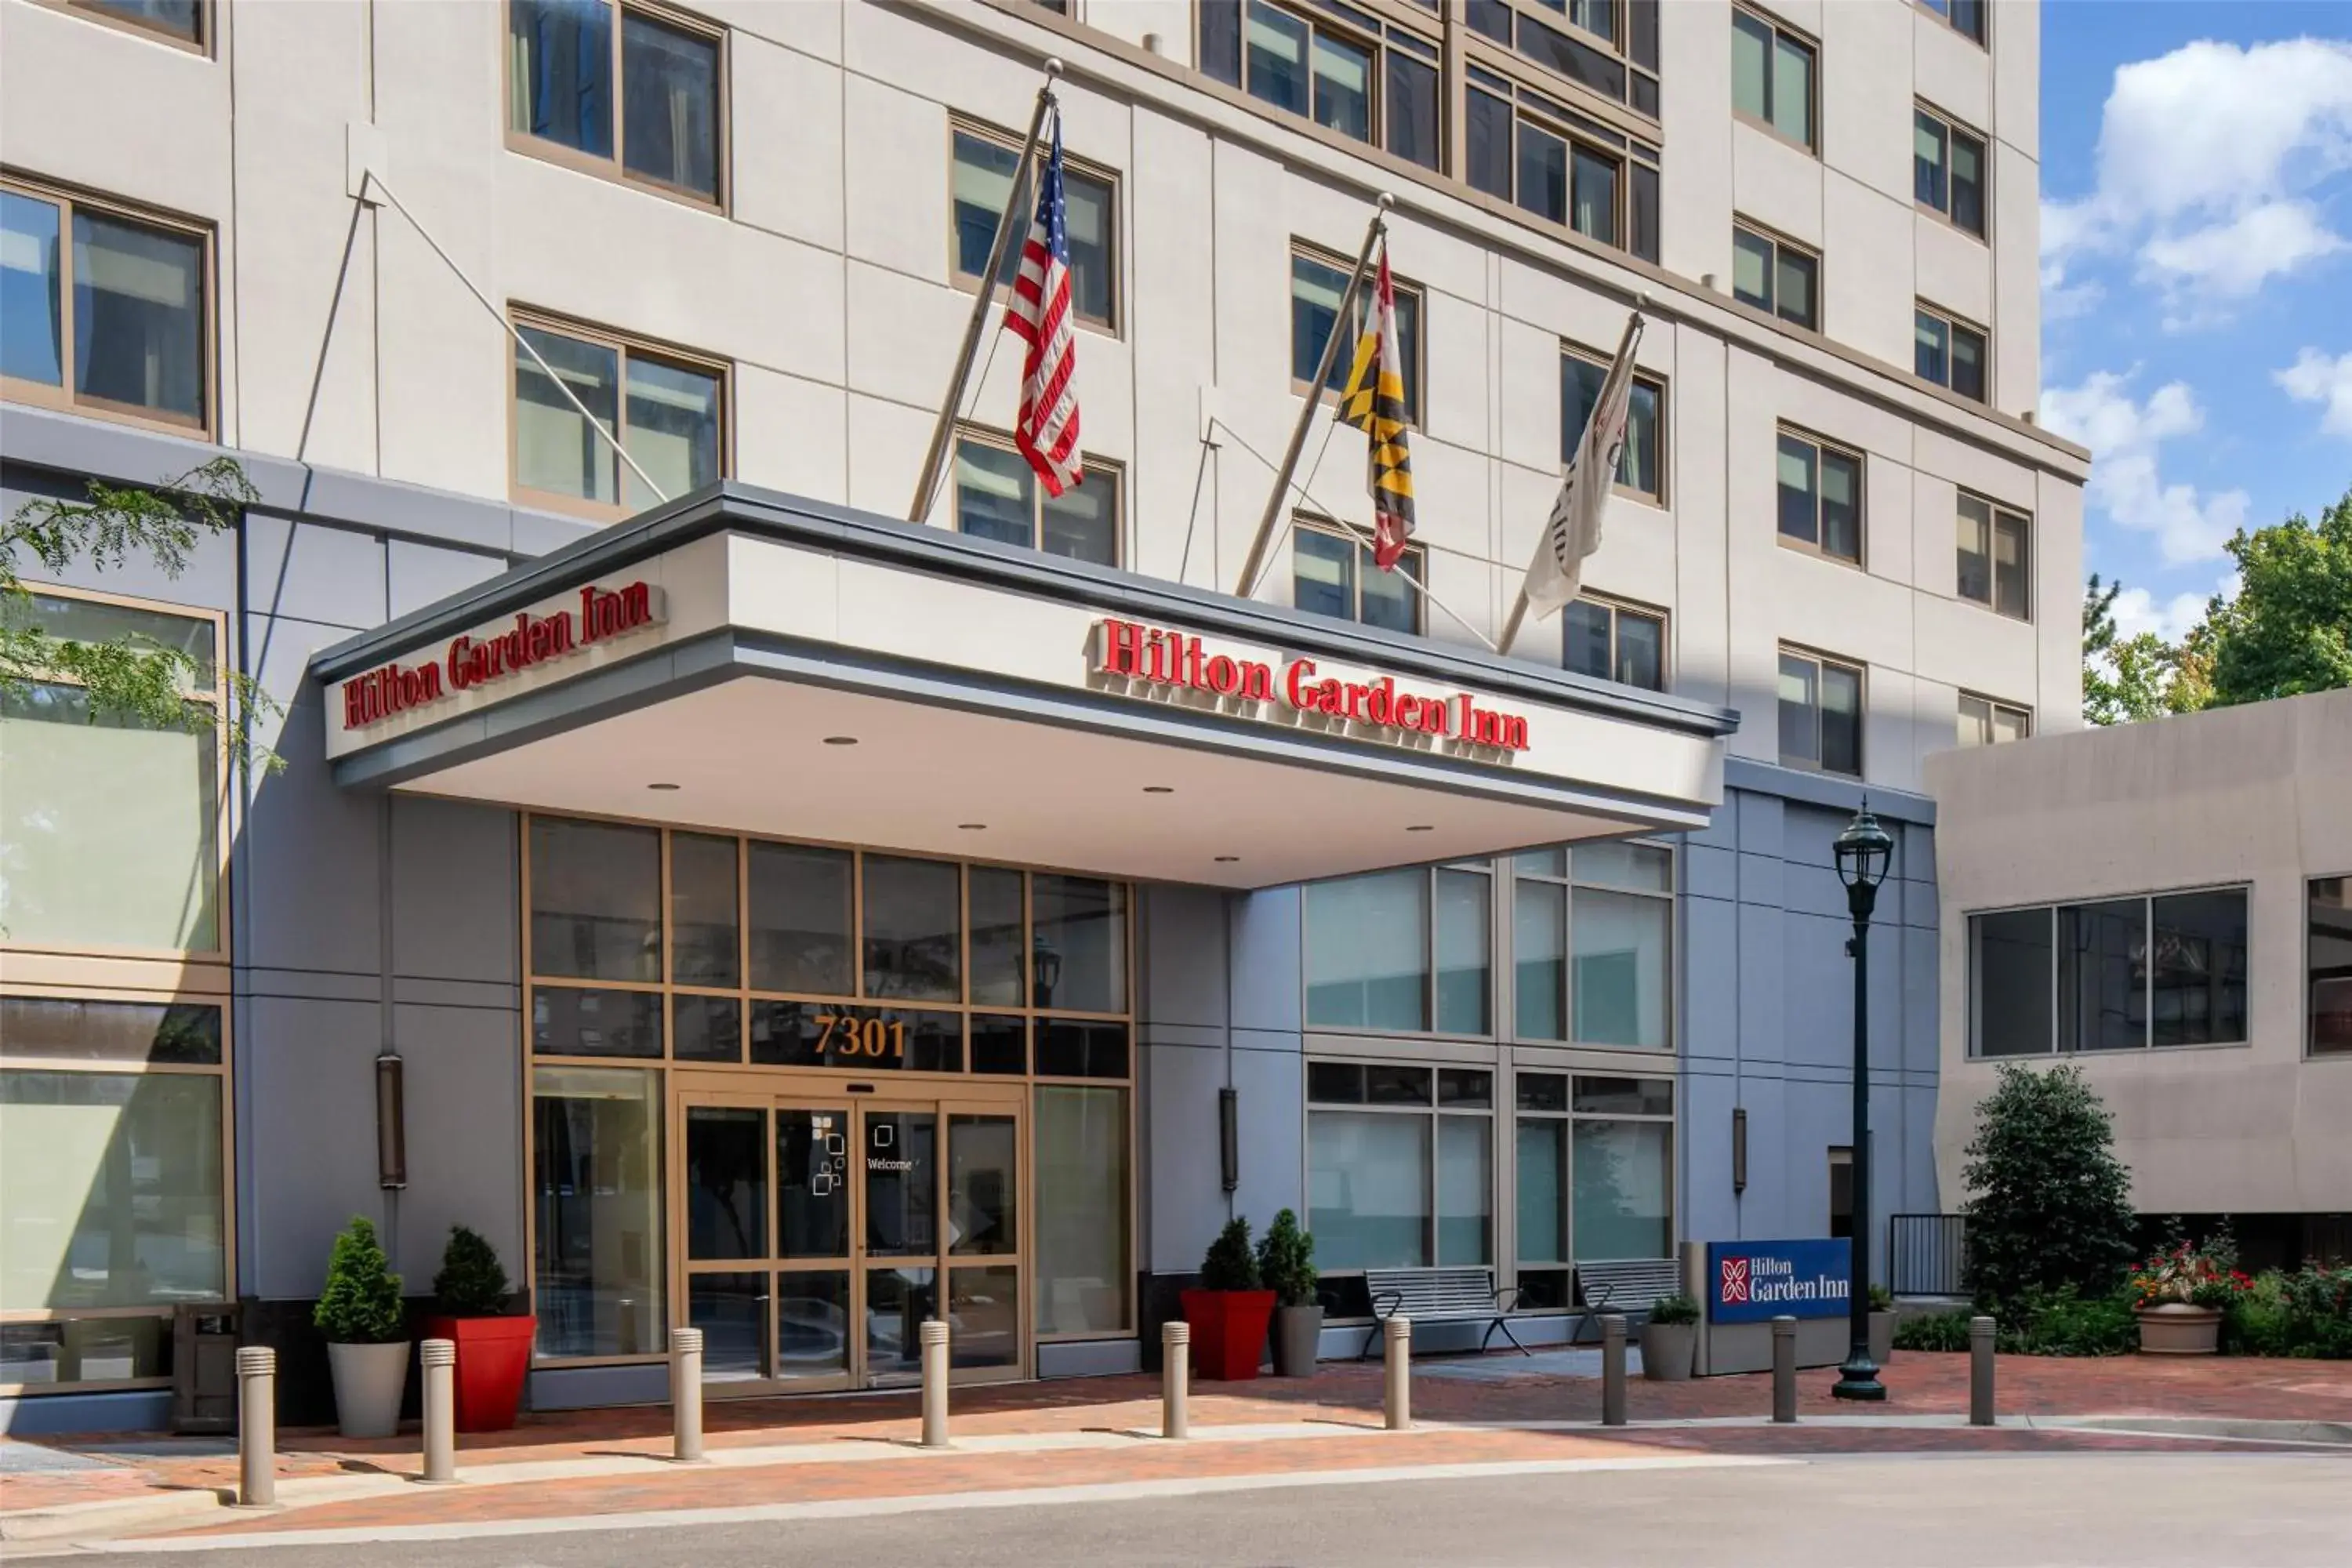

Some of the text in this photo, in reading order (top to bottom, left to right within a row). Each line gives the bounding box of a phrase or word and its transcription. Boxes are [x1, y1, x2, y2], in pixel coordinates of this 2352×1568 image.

[343, 581, 653, 730] Hilton Garden Inn
[1102, 618, 1530, 751] Hilton Garden Inn
[814, 1016, 905, 1057] 7301
[867, 1157, 912, 1171] Welcome
[1751, 1258, 1792, 1275] Hilton
[1751, 1274, 1850, 1302] Garden Inn
